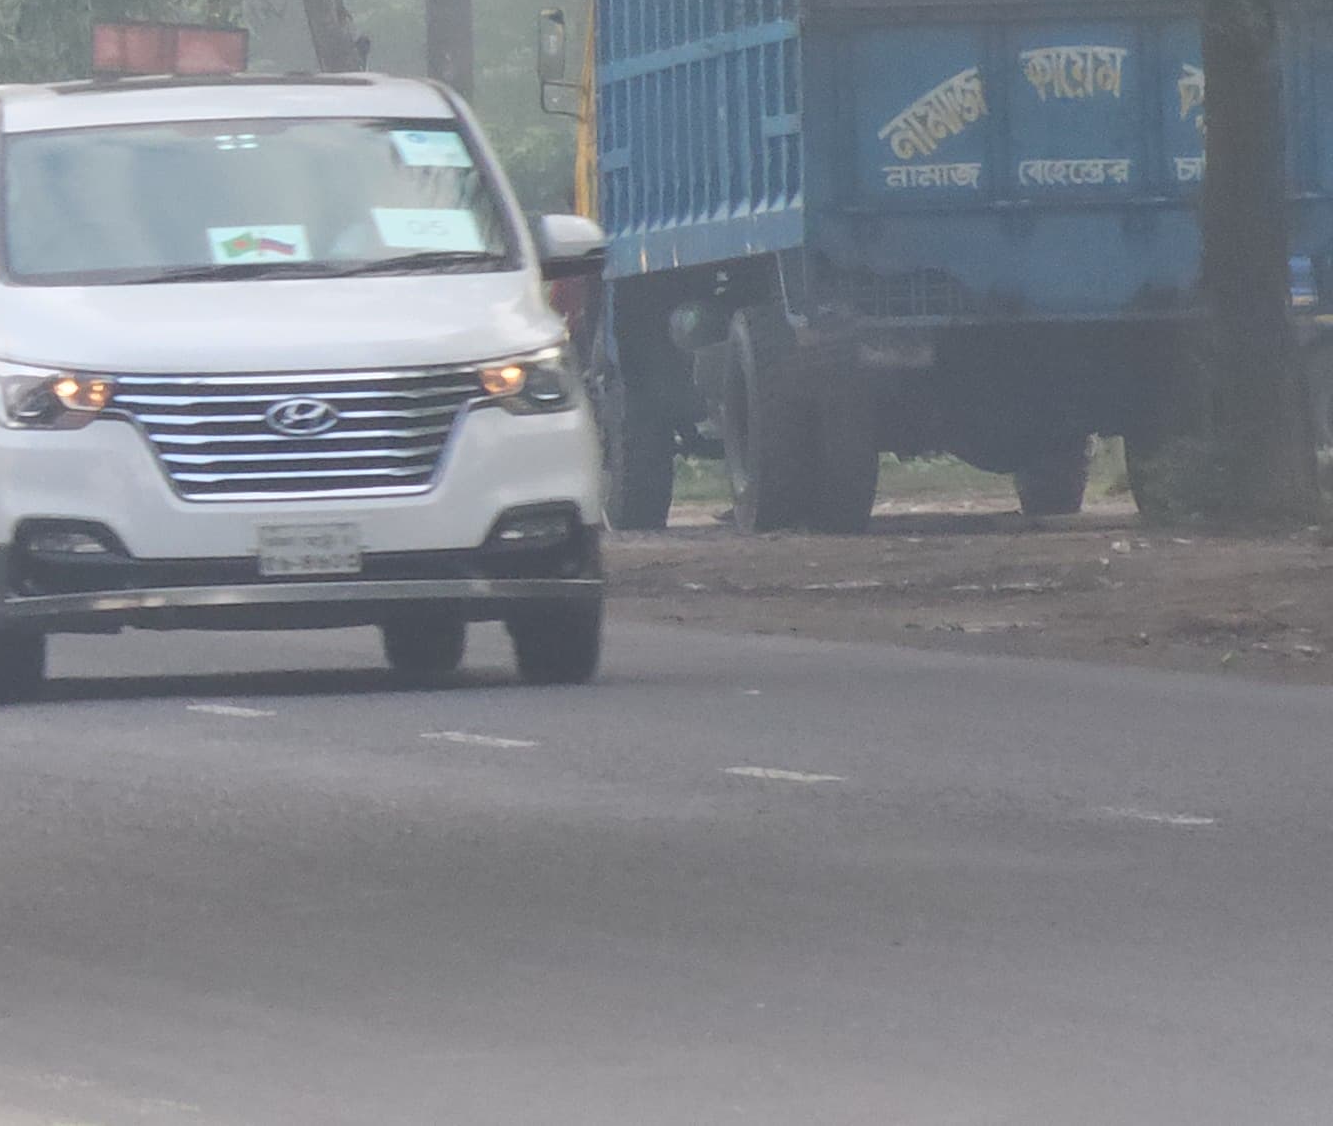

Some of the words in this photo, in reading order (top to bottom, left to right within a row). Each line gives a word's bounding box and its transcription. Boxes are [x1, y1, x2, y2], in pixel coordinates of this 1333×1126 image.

[878, 65, 990, 160] নামাজ
[1019, 45, 1128, 101] কায়েম
[882, 162, 983, 189] নামাজ
